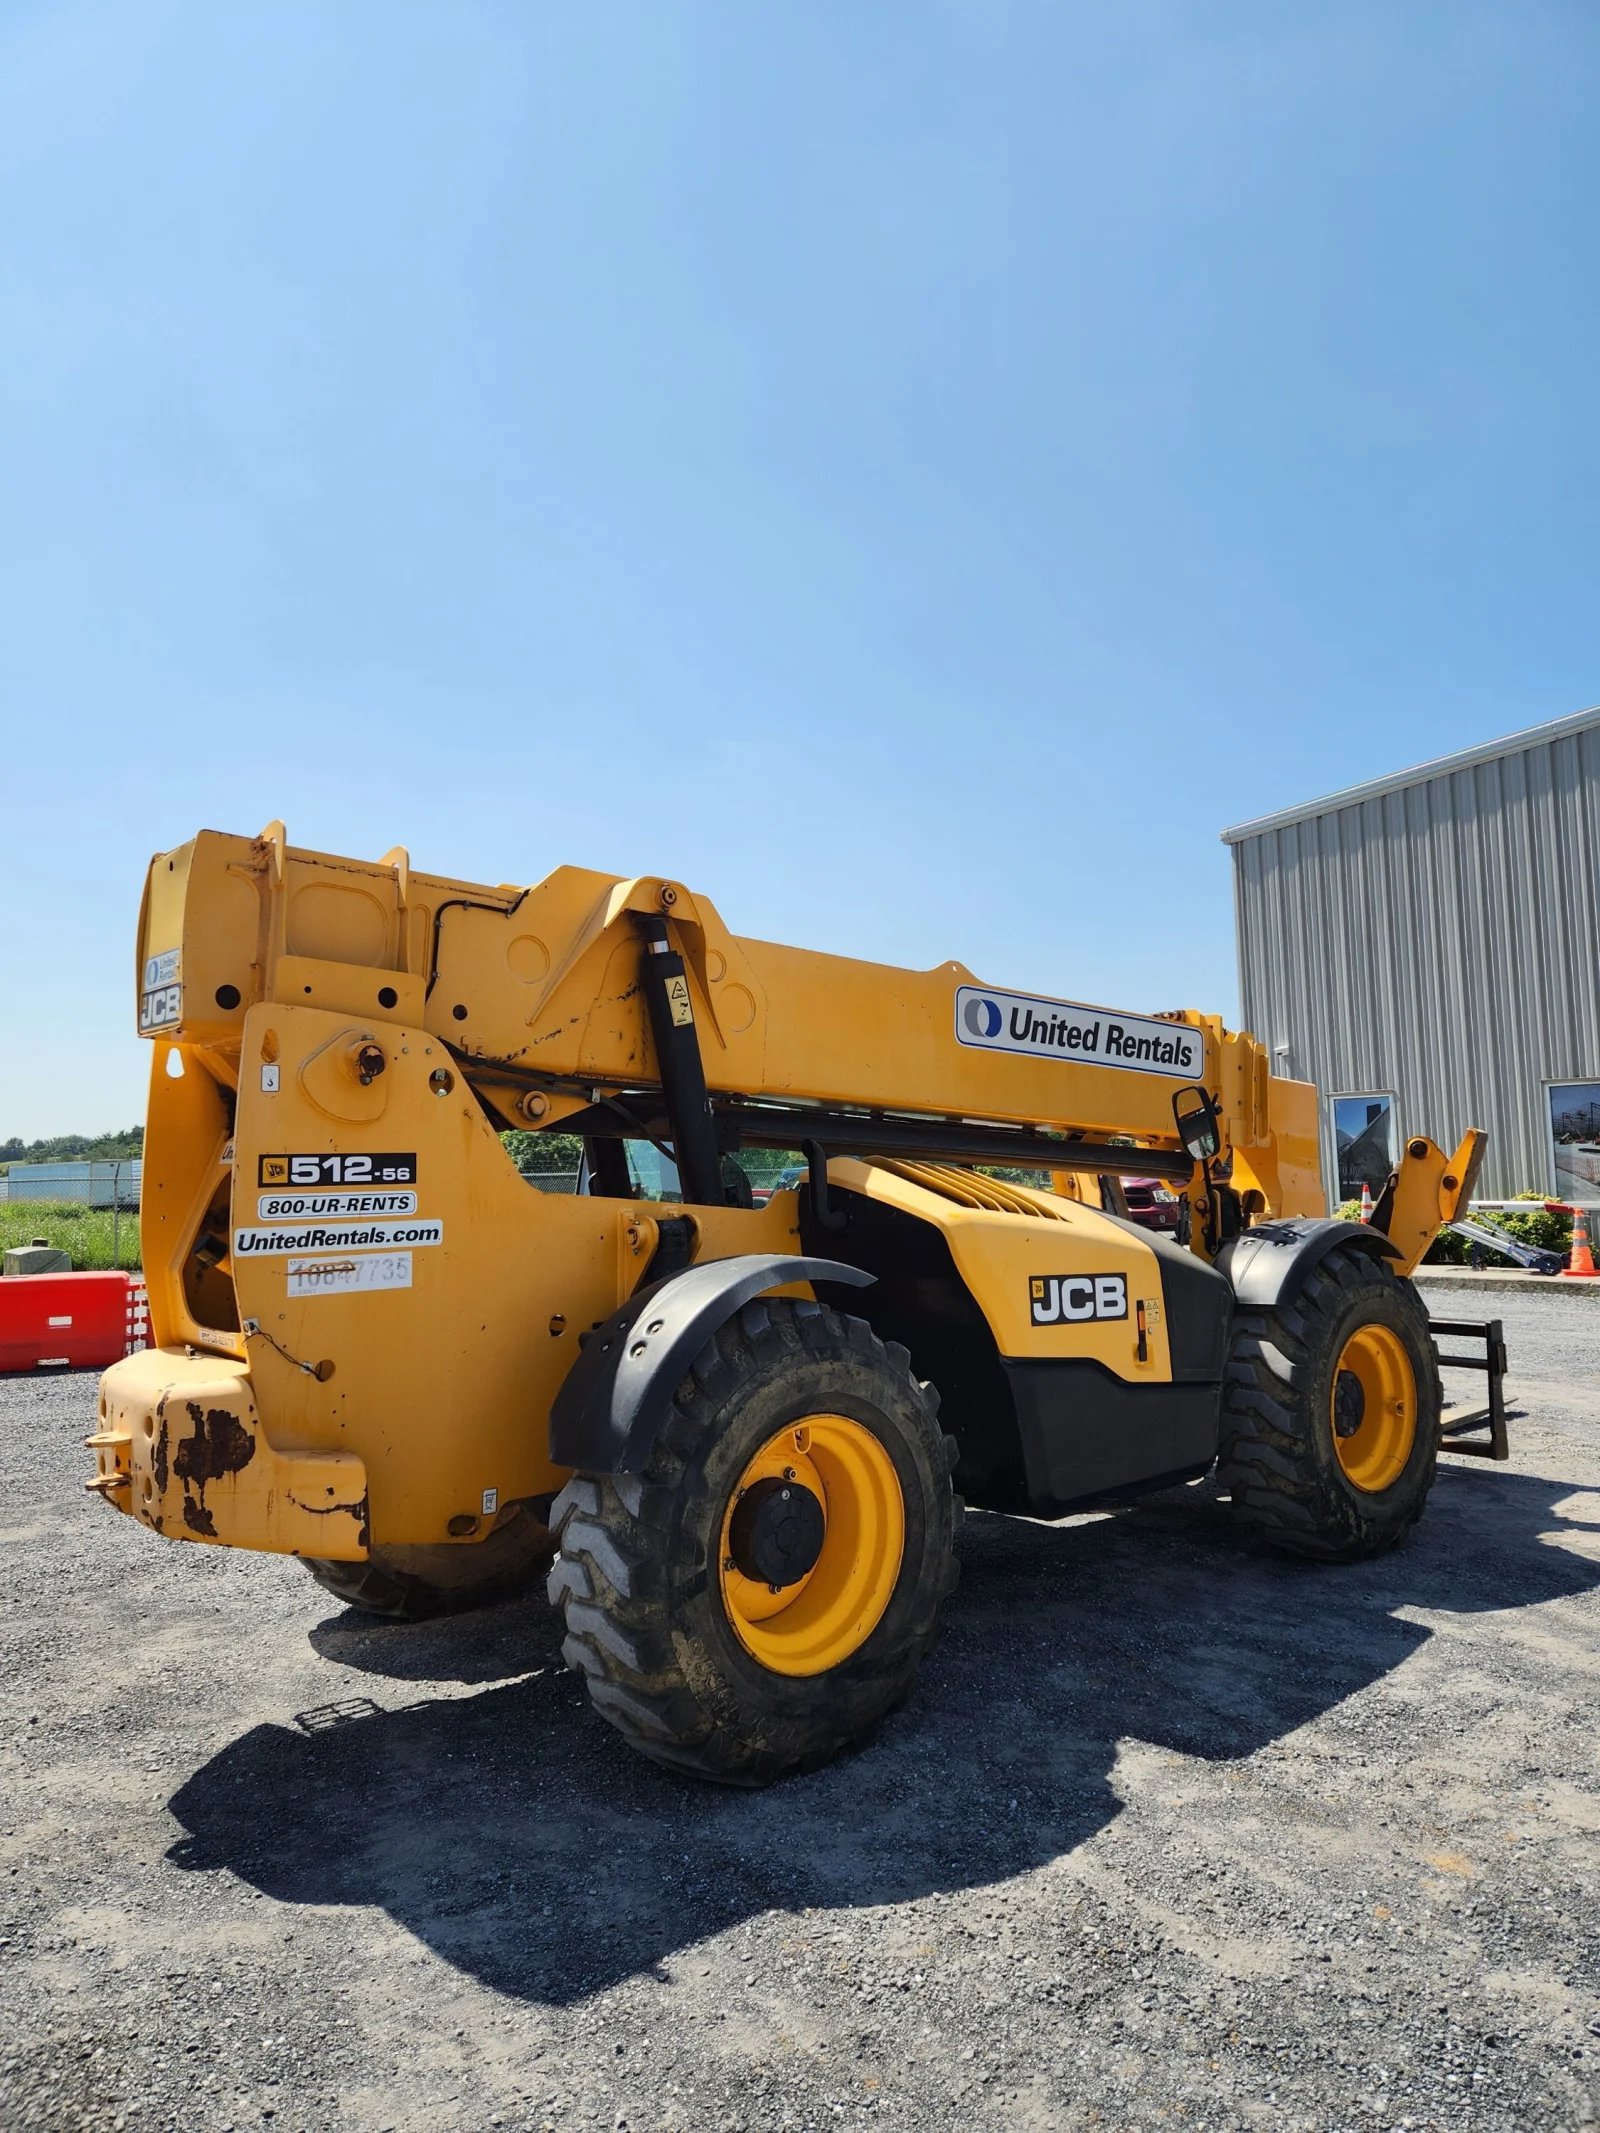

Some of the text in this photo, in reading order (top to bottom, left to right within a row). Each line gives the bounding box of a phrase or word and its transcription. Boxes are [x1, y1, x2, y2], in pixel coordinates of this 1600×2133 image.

[141, 986, 180, 1027] JCB
[1009, 1007, 1192, 1067] United Rentals
[291, 1156, 410, 1183] 512-56
[267, 1196, 410, 1214] 800-UR-RENTS
[238, 1227, 440, 1251] UnitedRentals.com
[1033, 1276, 1127, 1322] JCB
